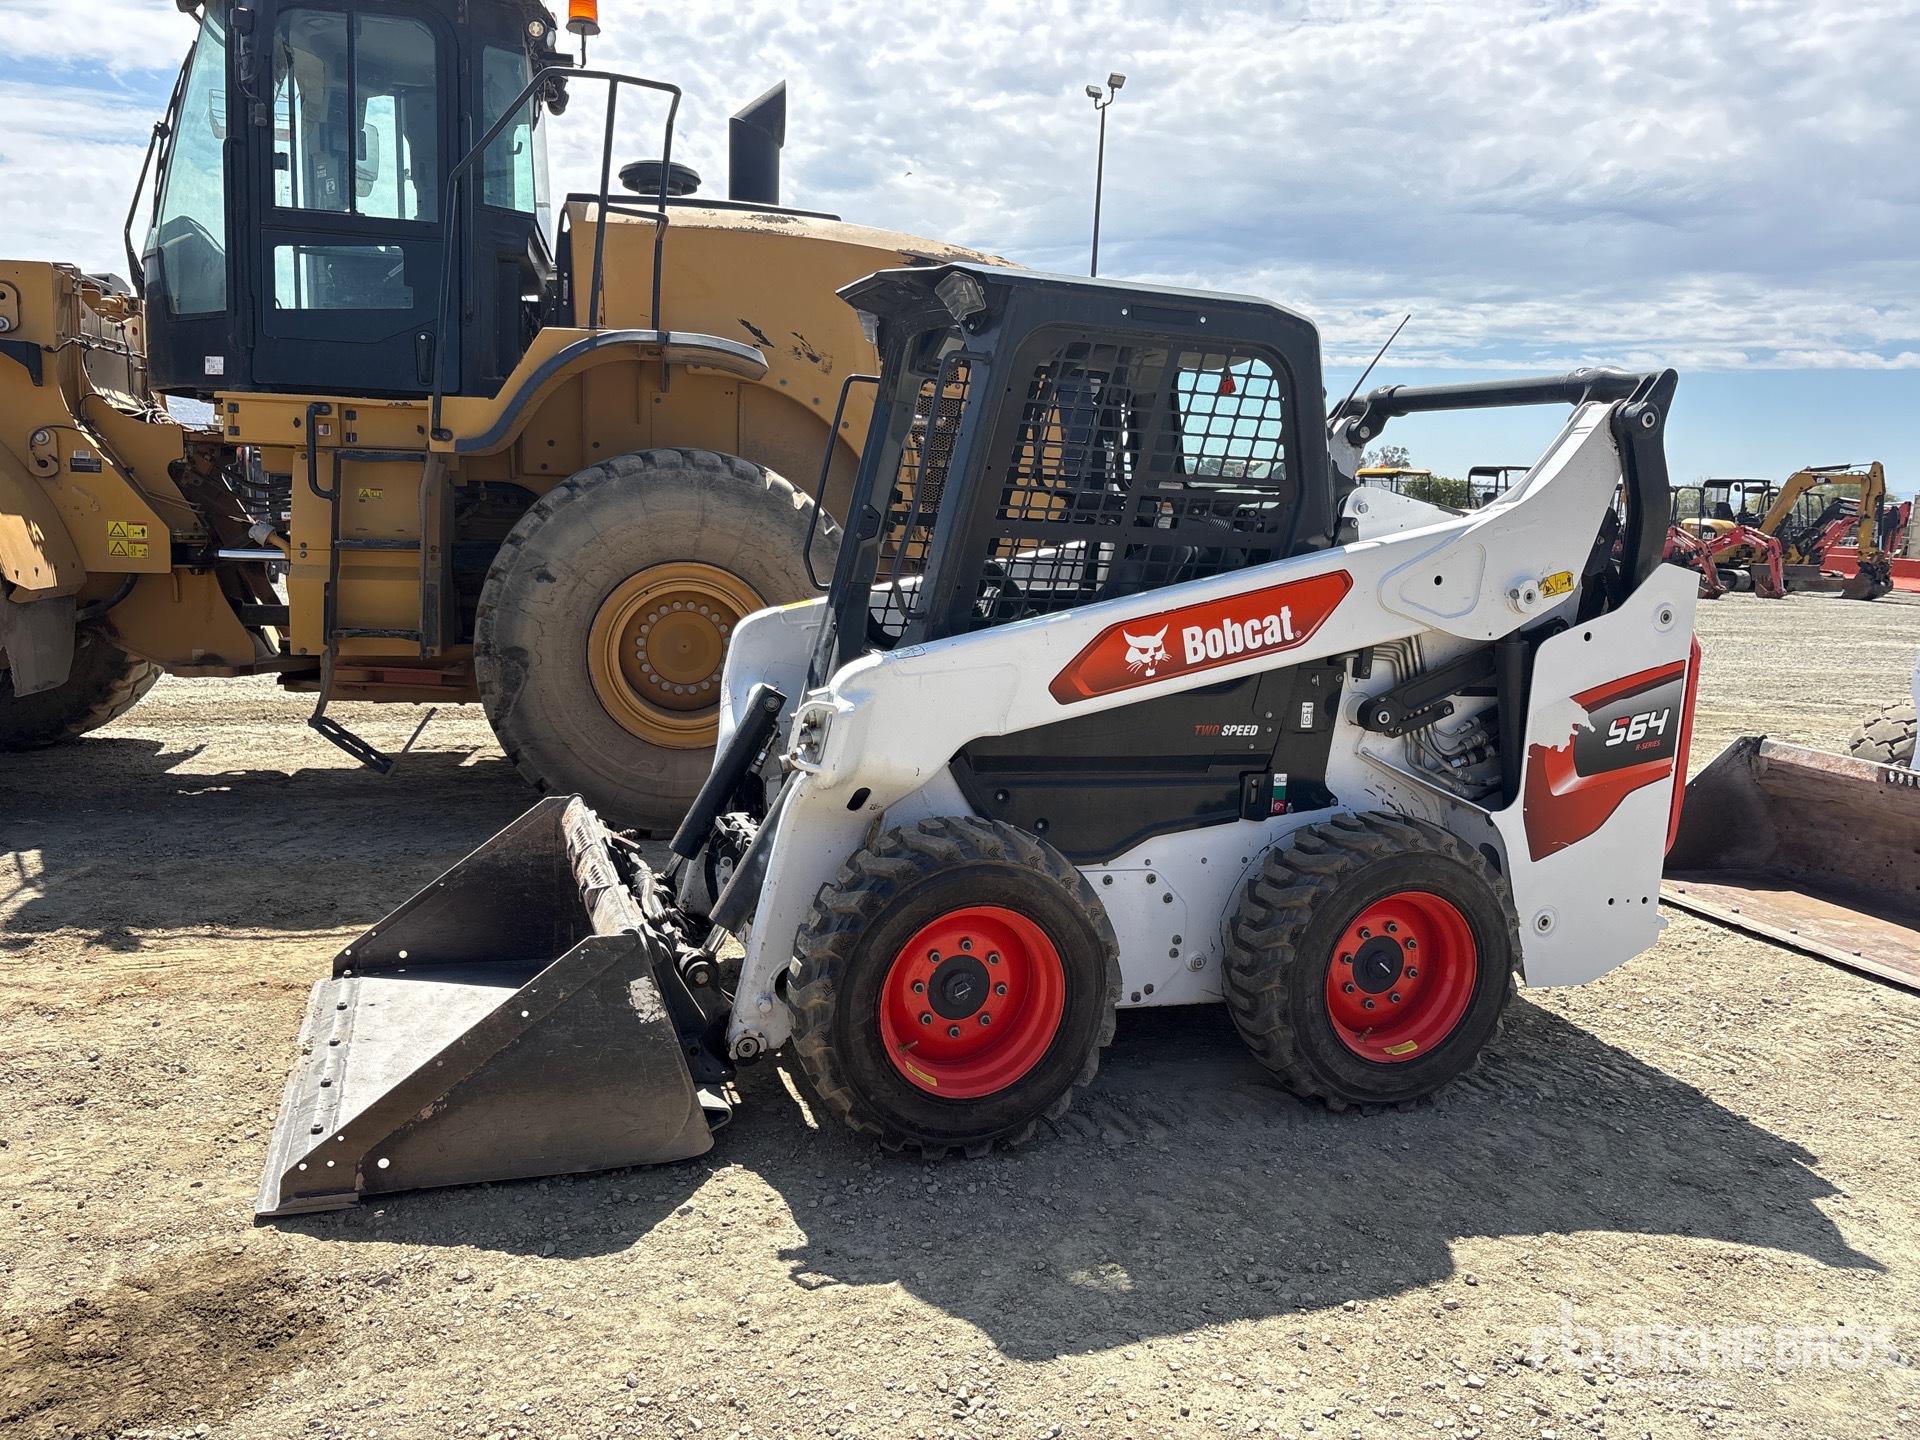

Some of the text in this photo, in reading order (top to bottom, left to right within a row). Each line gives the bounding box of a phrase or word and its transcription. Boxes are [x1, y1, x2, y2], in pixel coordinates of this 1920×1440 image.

[1702, 532, 1715, 540] CAT
[1182, 605, 1295, 665] Bobcat
[1195, 725, 1259, 736] TWO SPEED
[1605, 708, 1670, 747] S64
[1635, 740, 1661, 751] R-SERIES
